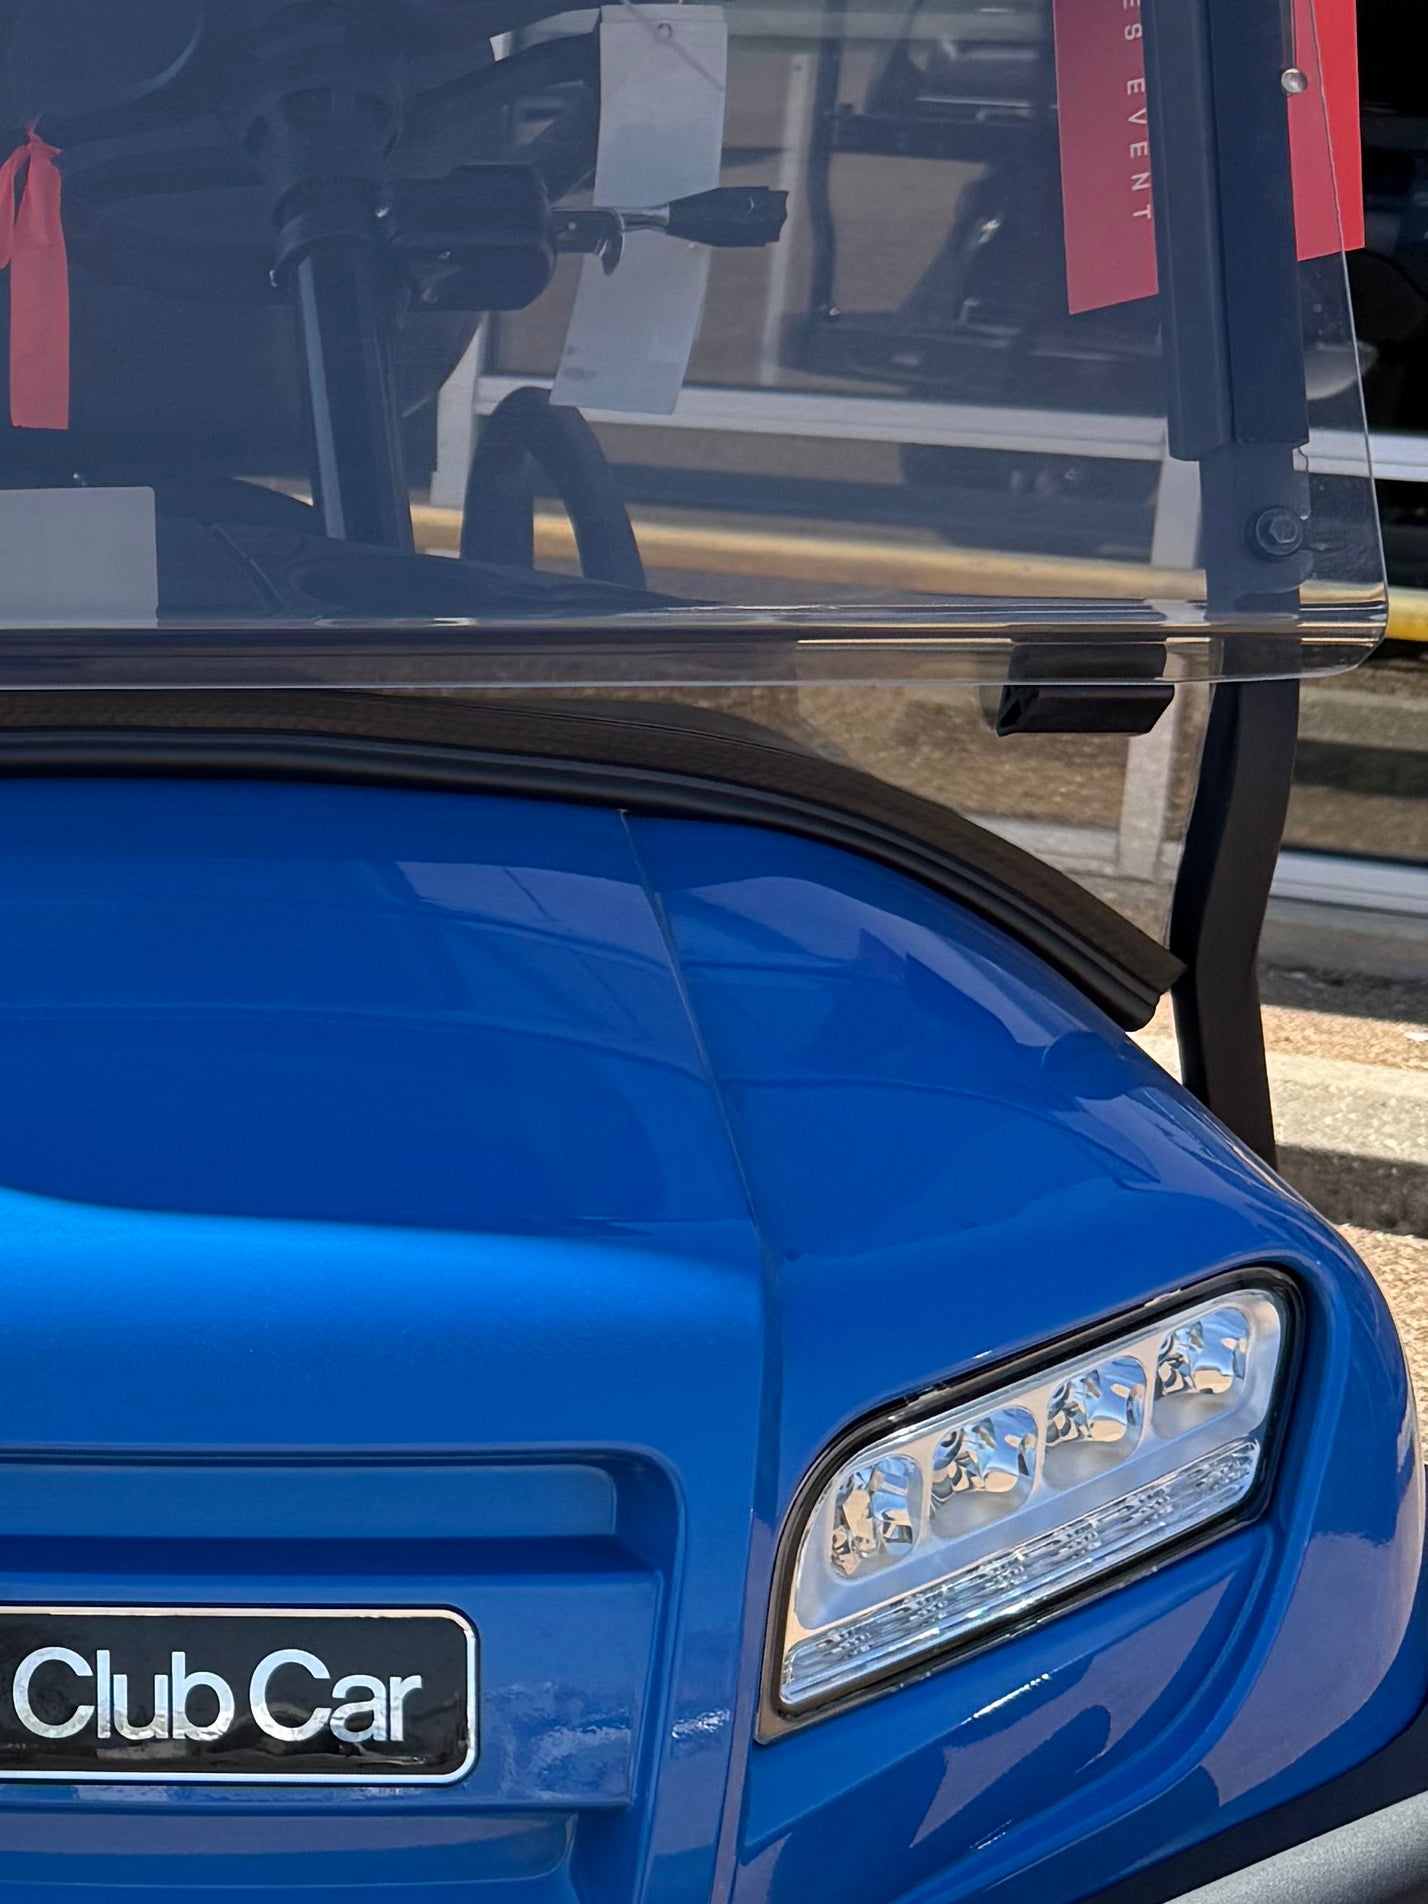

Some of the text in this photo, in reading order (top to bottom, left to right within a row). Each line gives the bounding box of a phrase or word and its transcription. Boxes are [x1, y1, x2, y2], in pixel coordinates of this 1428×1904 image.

[1126, 77, 1152, 220] EVENT
[12, 1646, 423, 1743] Club Car
